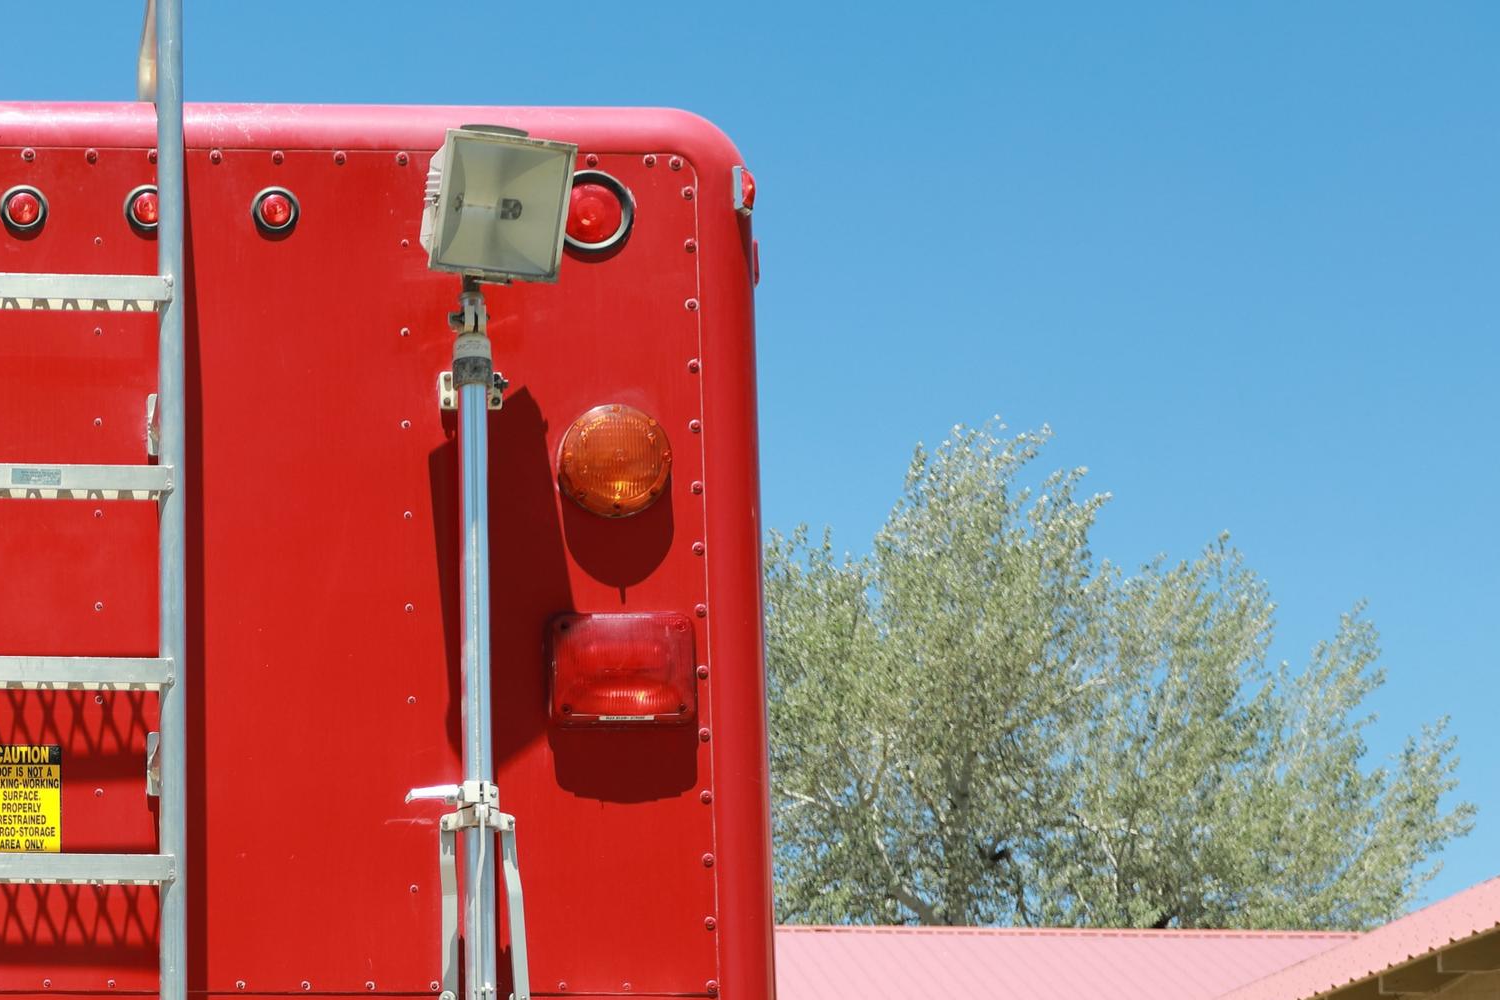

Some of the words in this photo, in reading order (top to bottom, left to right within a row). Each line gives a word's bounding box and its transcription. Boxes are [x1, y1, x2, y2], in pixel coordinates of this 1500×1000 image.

[16, 767, 24, 777] IS
[28, 767, 43, 777] NOT
[47, 767, 52, 777] A
[3, 791, 41, 801] SURFACE.
[2, 803, 41, 813] PROPERLY
[0, 839, 21, 849] AREA
[25, 839, 47, 849] ONLY.
